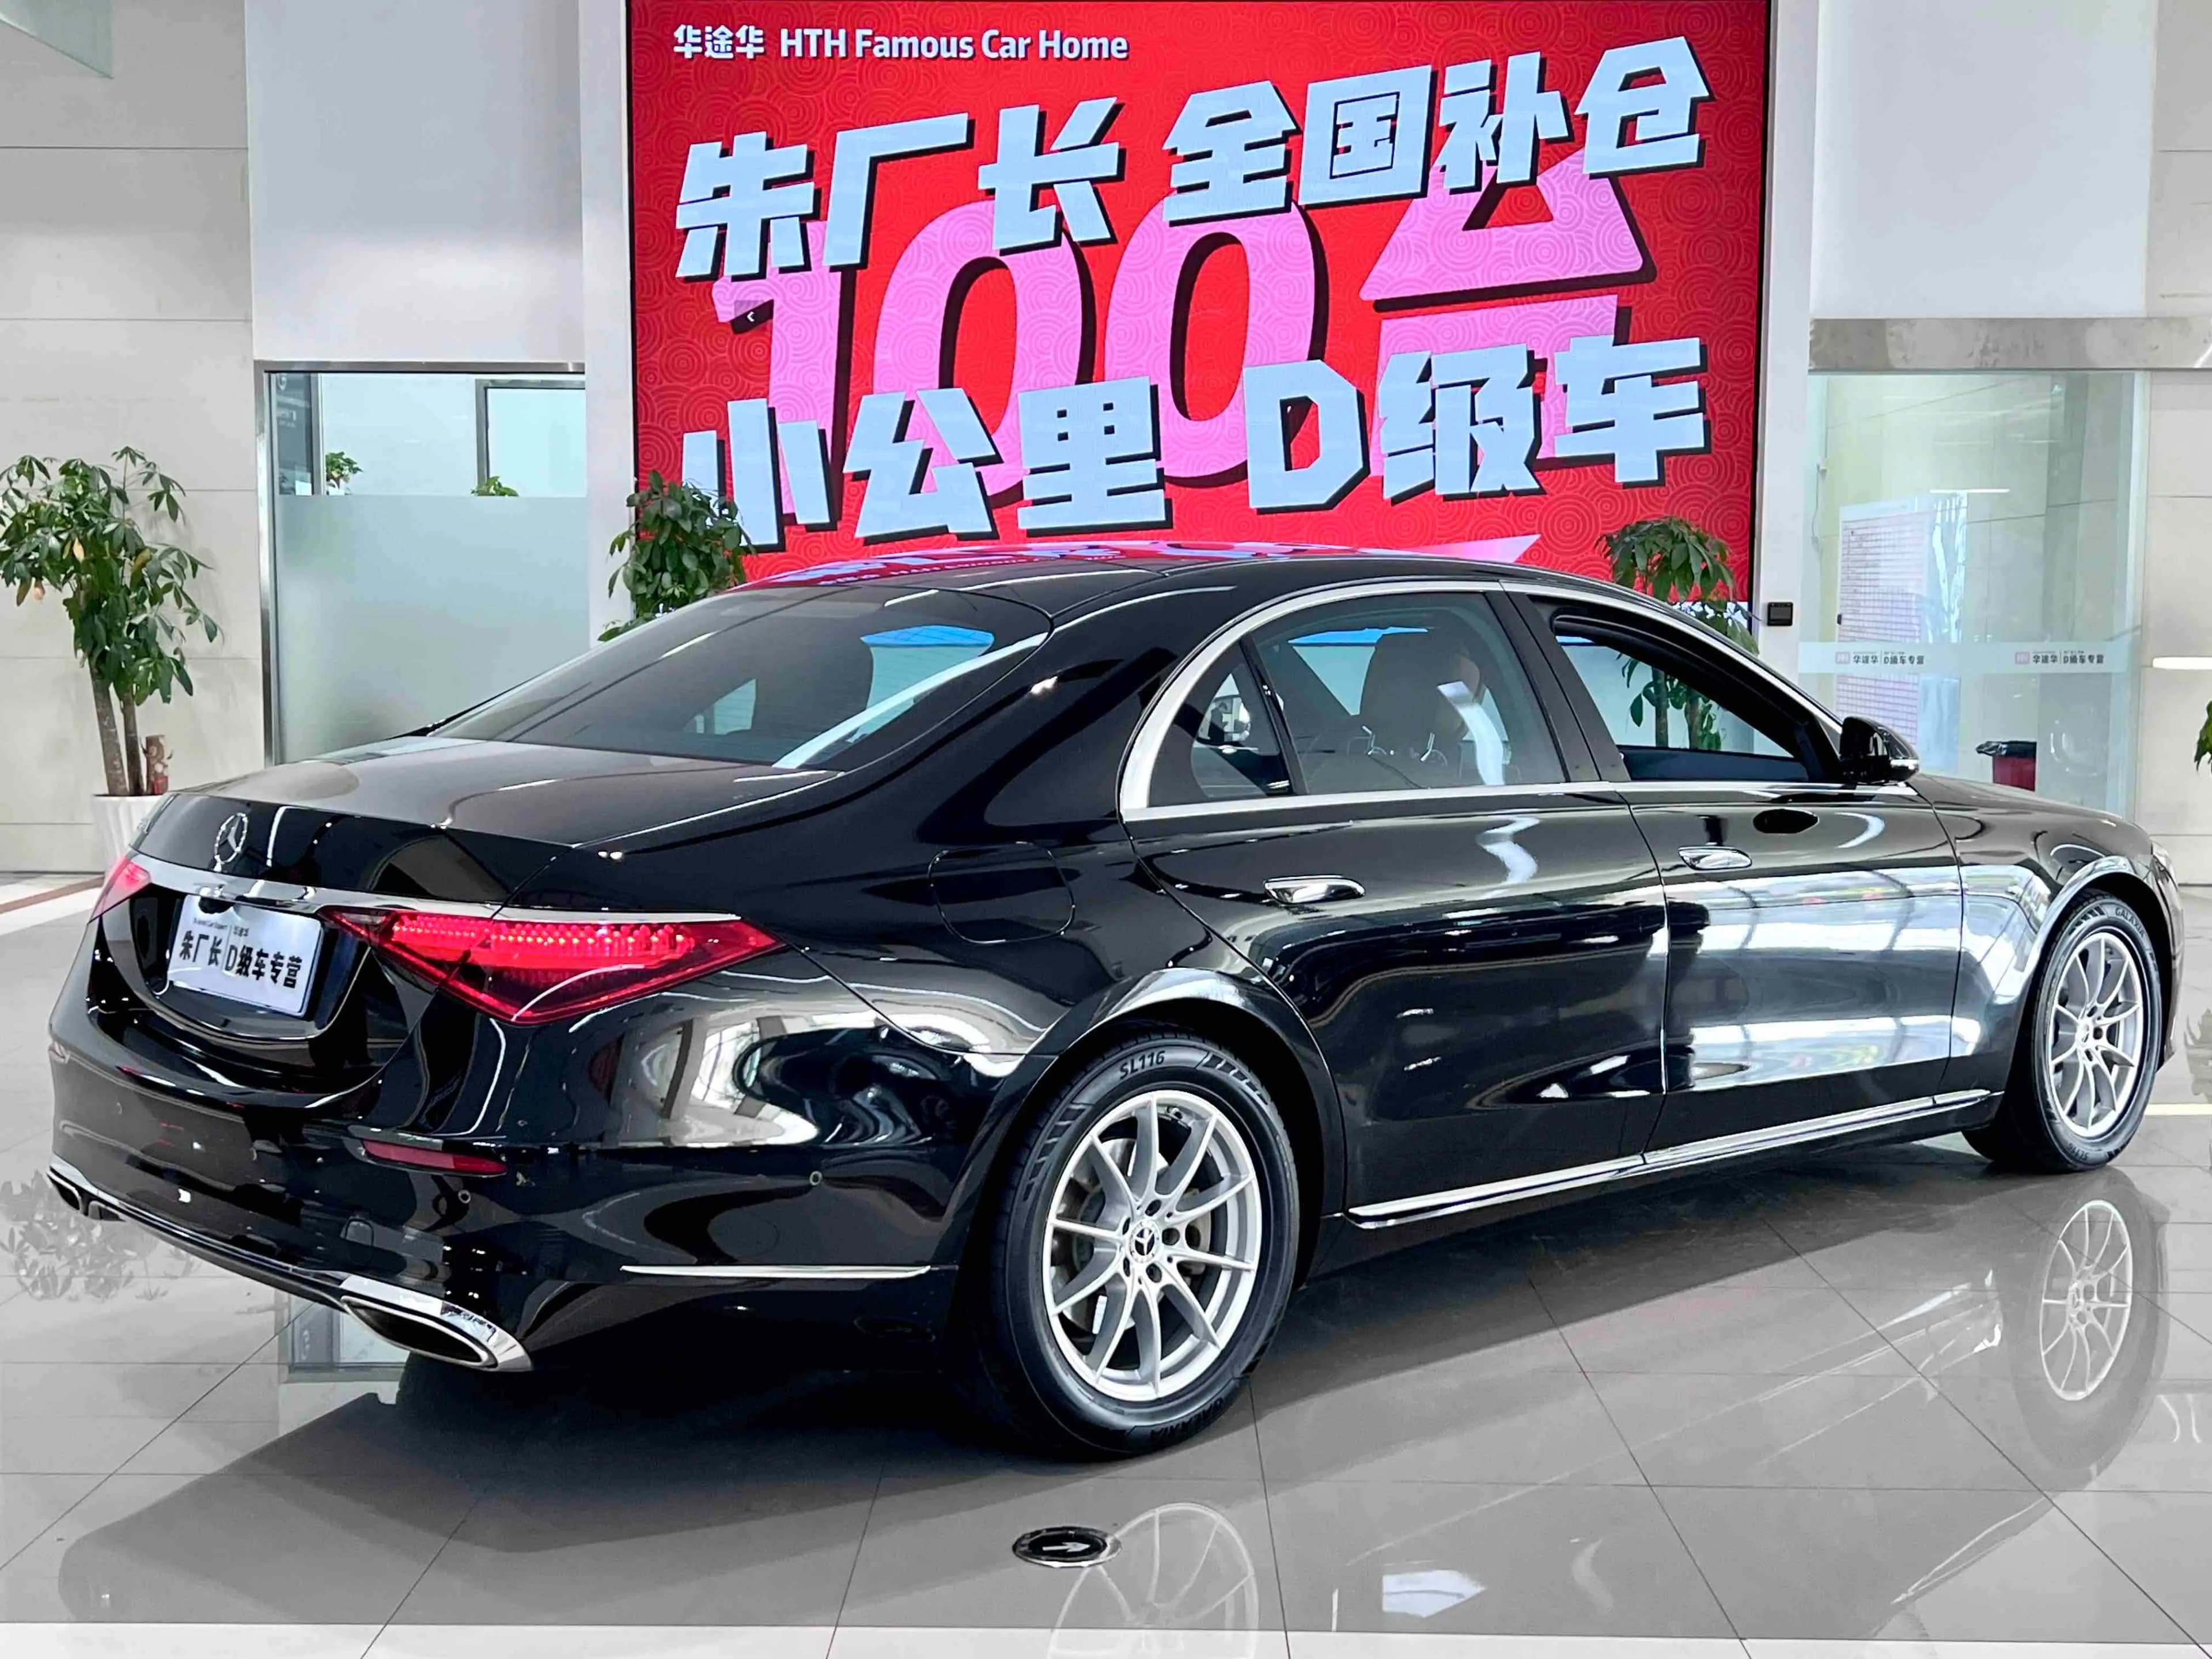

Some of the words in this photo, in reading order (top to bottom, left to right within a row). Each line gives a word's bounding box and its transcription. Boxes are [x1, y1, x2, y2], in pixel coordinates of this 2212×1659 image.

[673, 24, 764, 59] 华途华
[780, 28, 846, 57] HTH
[855, 29, 974, 59] Famous
[981, 29, 1031, 59] Car
[1039, 30, 1128, 59] Home
[675, 97, 1120, 278] 朱厂长
[1162, 37, 1710, 224] 全国补仓
[681, 376, 1166, 545] 小公里
[1243, 334, 1705, 509] D级车
[224, 944, 302, 989] D级车专营
[1119, 1050, 1166, 1080] SL116
